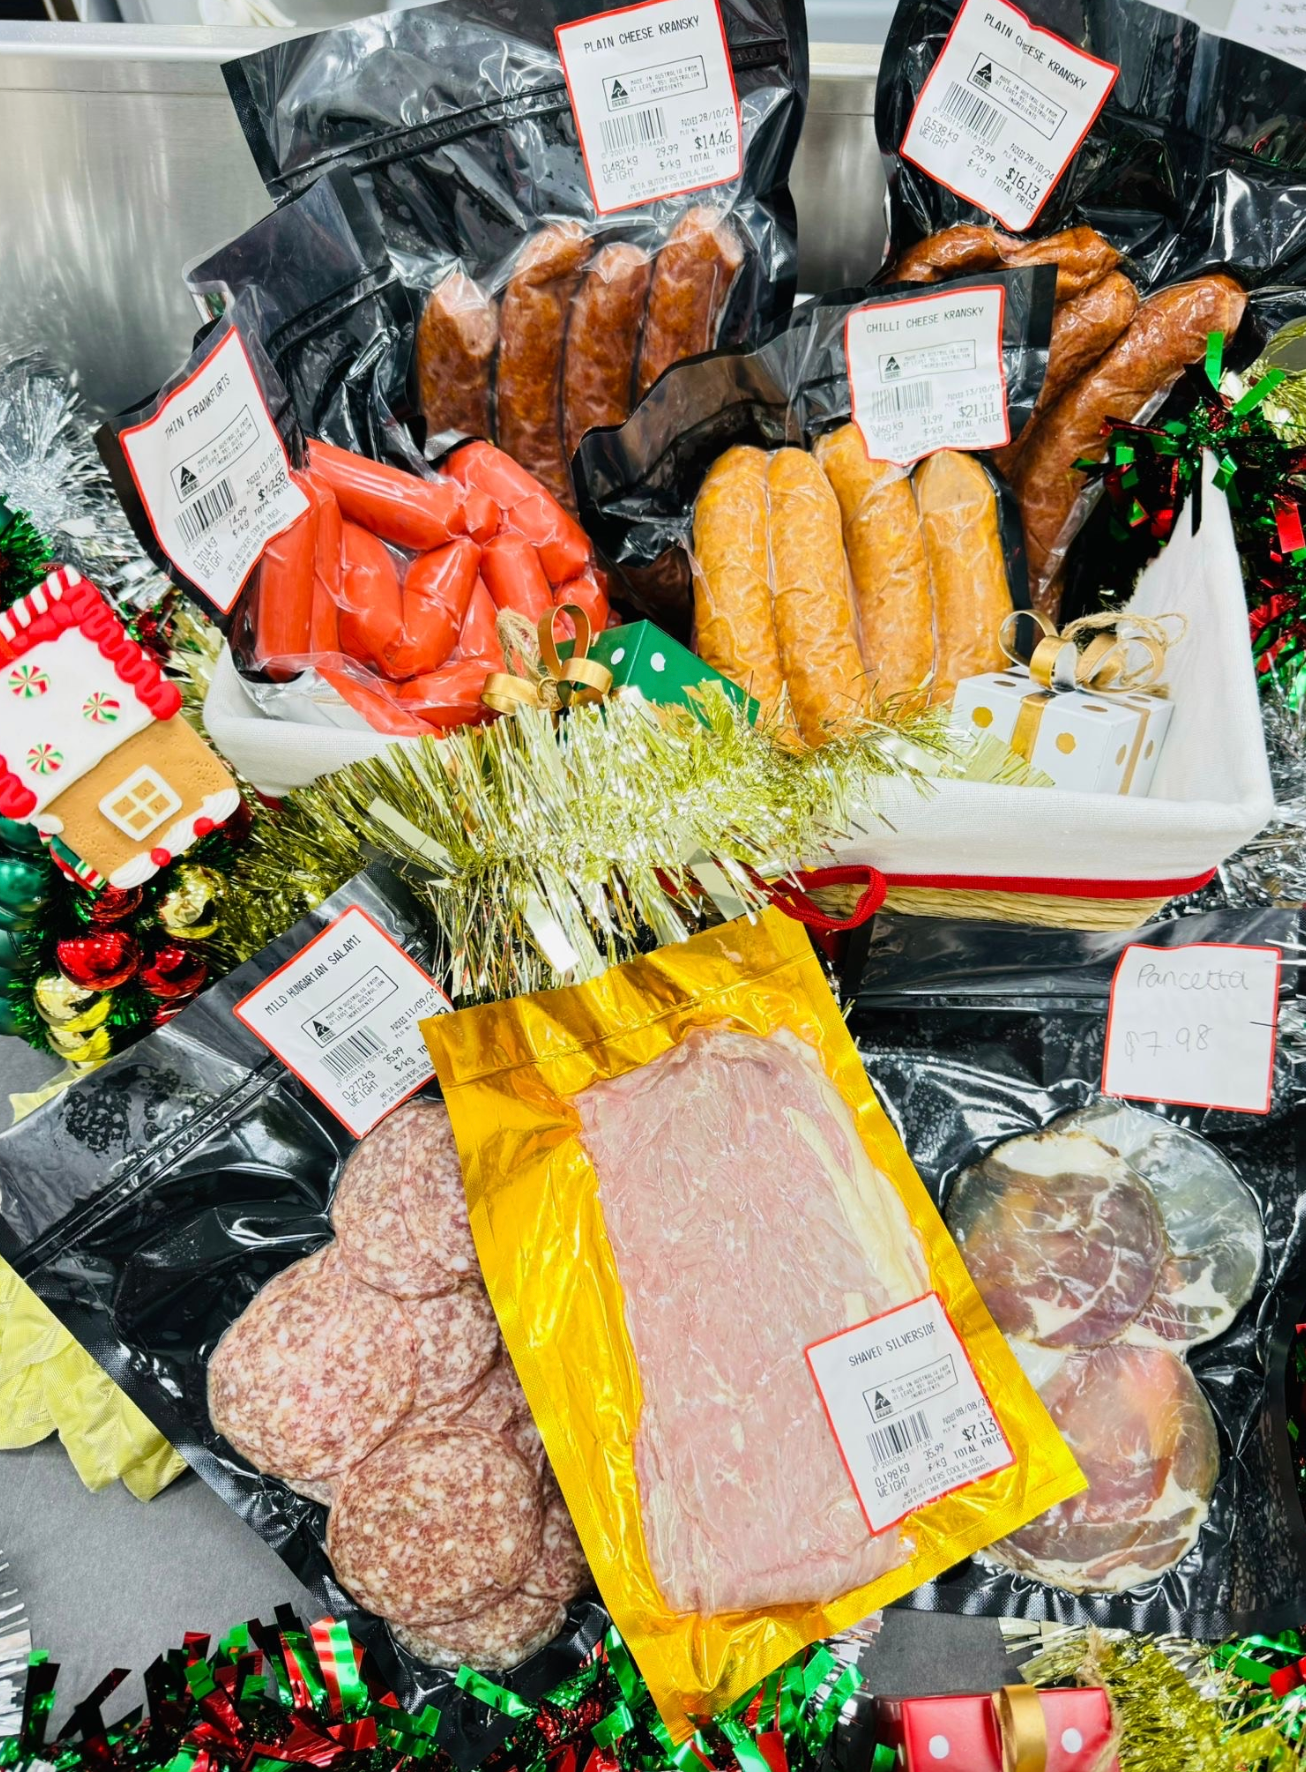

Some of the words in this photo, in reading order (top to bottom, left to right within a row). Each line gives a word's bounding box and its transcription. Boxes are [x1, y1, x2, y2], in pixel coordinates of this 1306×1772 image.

[584, 36, 614, 52] PLAIN
[618, 26, 654, 44] CHEESE
[658, 16, 698, 34] KRANSKY
[984, 13, 1013, 38] PLAIN
[1015, 35, 1046, 64] CHEESE
[1048, 59, 1086, 89] KRANSKY
[698, 106, 734, 122] 28/10/24
[694, 129, 732, 150] $14.46
[919, 126, 948, 149] WEIGHT
[923, 116, 947, 136] 0.538
[947, 129, 959, 143] kg
[655, 143, 678, 158] 29.99
[689, 152, 710, 163] TOTAL
[716, 144, 736, 157] PRICE
[971, 145, 996, 164] 29.99
[602, 159, 625, 174] 0.482
[626, 155, 638, 166] kg
[603, 167, 634, 184] WEIGHT
[1024, 153, 1055, 180] 28/10/24
[994, 176, 1012, 195] TOTAL
[1015, 192, 1035, 212] PRICE
[1005, 167, 1040, 200] $16.13
[866, 321, 899, 333] CHILLI
[906, 313, 938, 328] CHEESE
[944, 306, 984, 321] KRANSKY
[165, 416, 184, 437] THIN
[187, 374, 230, 421] FRANKFURTS
[958, 402, 994, 418] $21.11
[920, 414, 942, 425] 31.99
[952, 420, 972, 429] TOTAL
[978, 412, 1001, 424] PRICE
[260, 444, 282, 474] 13/10/24
[258, 468, 286, 506] $10.55
[228, 506, 247, 527] 14.99
[254, 496, 270, 516] TOTAL
[200, 550, 223, 579] WEIGHT
[264, 995, 288, 1016] MILD
[286, 963, 328, 998] HUNGARIAN
[328, 935, 361, 965] SALAMI
[1137, 963, 1249, 990] Pancetta
[405, 988, 437, 1018] 11/09/24
[383, 1046, 404, 1065] 35.99
[1124, 1024, 1213, 1063] $7.98
[342, 1077, 367, 1102] 0.272
[362, 1069, 375, 1081] kg
[348, 1077, 378, 1107] WEIGHT
[849, 1346, 882, 1366] SHAVED
[886, 1322, 935, 1351] SILVERSIDE
[962, 1417, 997, 1442] $7.13
[923, 1442, 944, 1461] 35.99
[954, 1444, 977, 1459] TOTAL
[874, 1469, 899, 1488] 0.198
[898, 1462, 910, 1474] kg
[877, 1476, 908, 1498] WEIGHT
